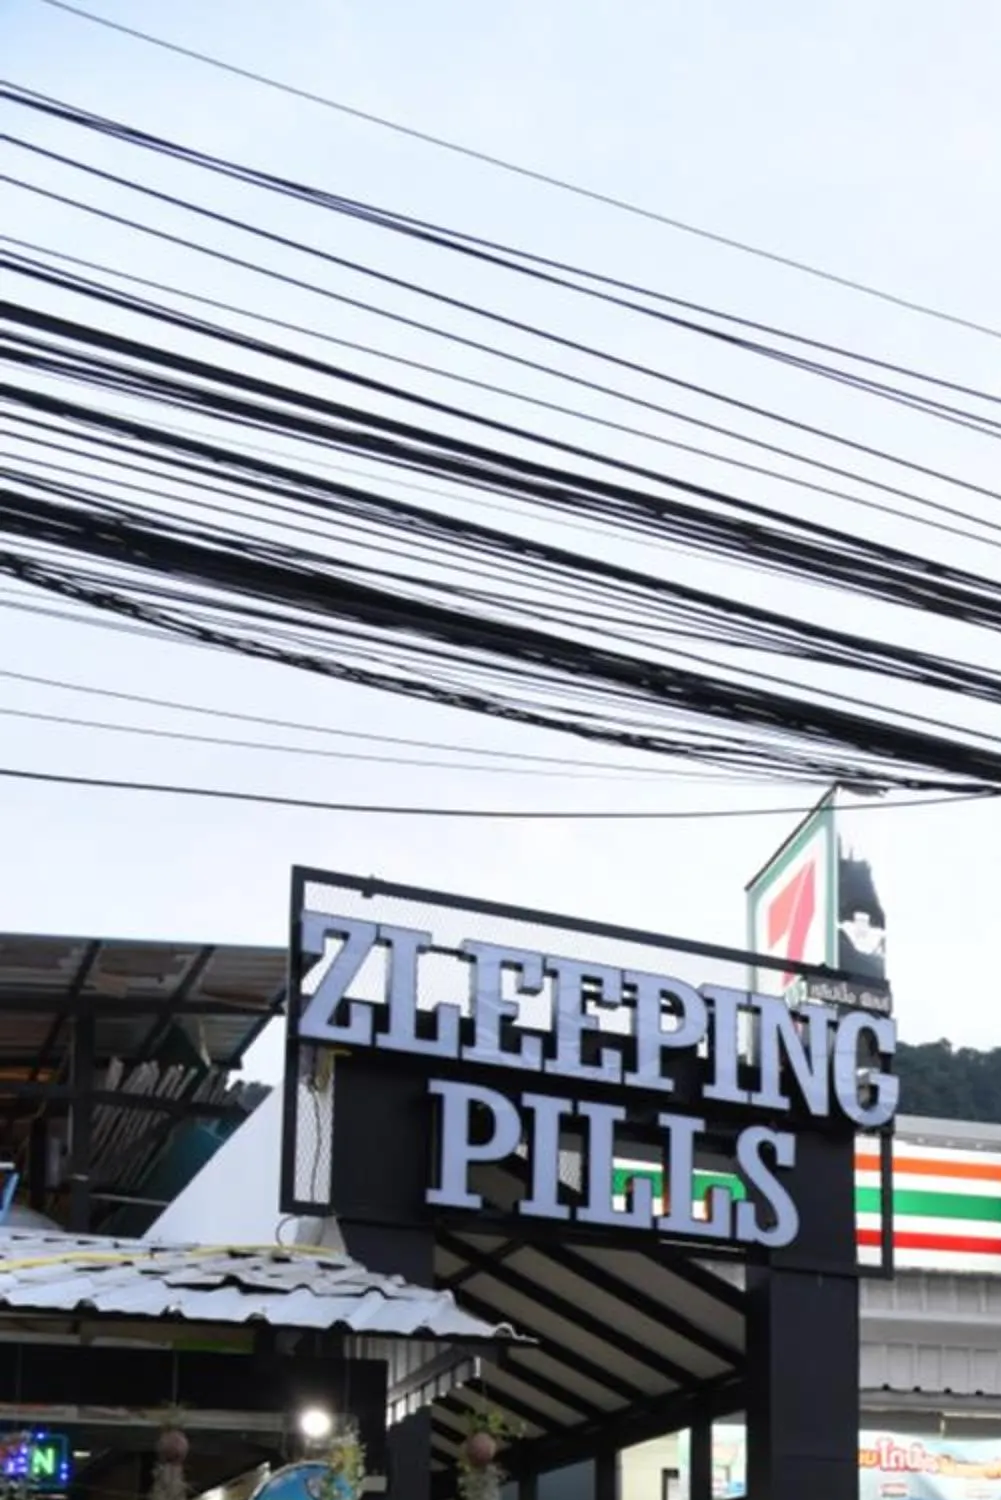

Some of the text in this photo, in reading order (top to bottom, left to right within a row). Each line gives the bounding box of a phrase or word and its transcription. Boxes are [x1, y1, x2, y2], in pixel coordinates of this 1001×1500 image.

[767, 858, 816, 990] 7
[299, 910, 899, 1249] ZLEEPING PILLS
